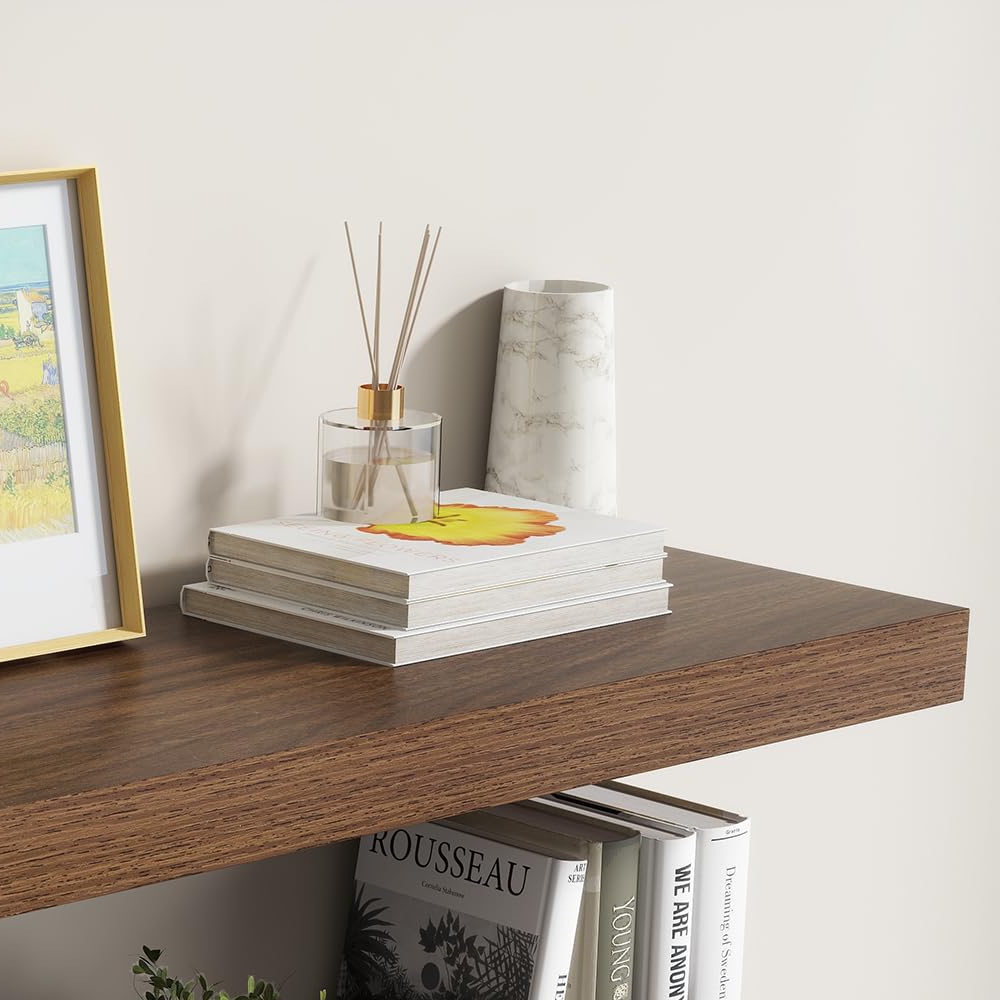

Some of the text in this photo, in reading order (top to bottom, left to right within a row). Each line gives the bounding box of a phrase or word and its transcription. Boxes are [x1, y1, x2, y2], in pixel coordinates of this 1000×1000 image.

[369, 829, 531, 896] ROUSSEAU
[673, 863, 692, 896] WE
[610, 895, 636, 982] YOUNG
[671, 901, 690, 939] ARE
[719, 866, 737, 1000] Dreaming of Sweden
